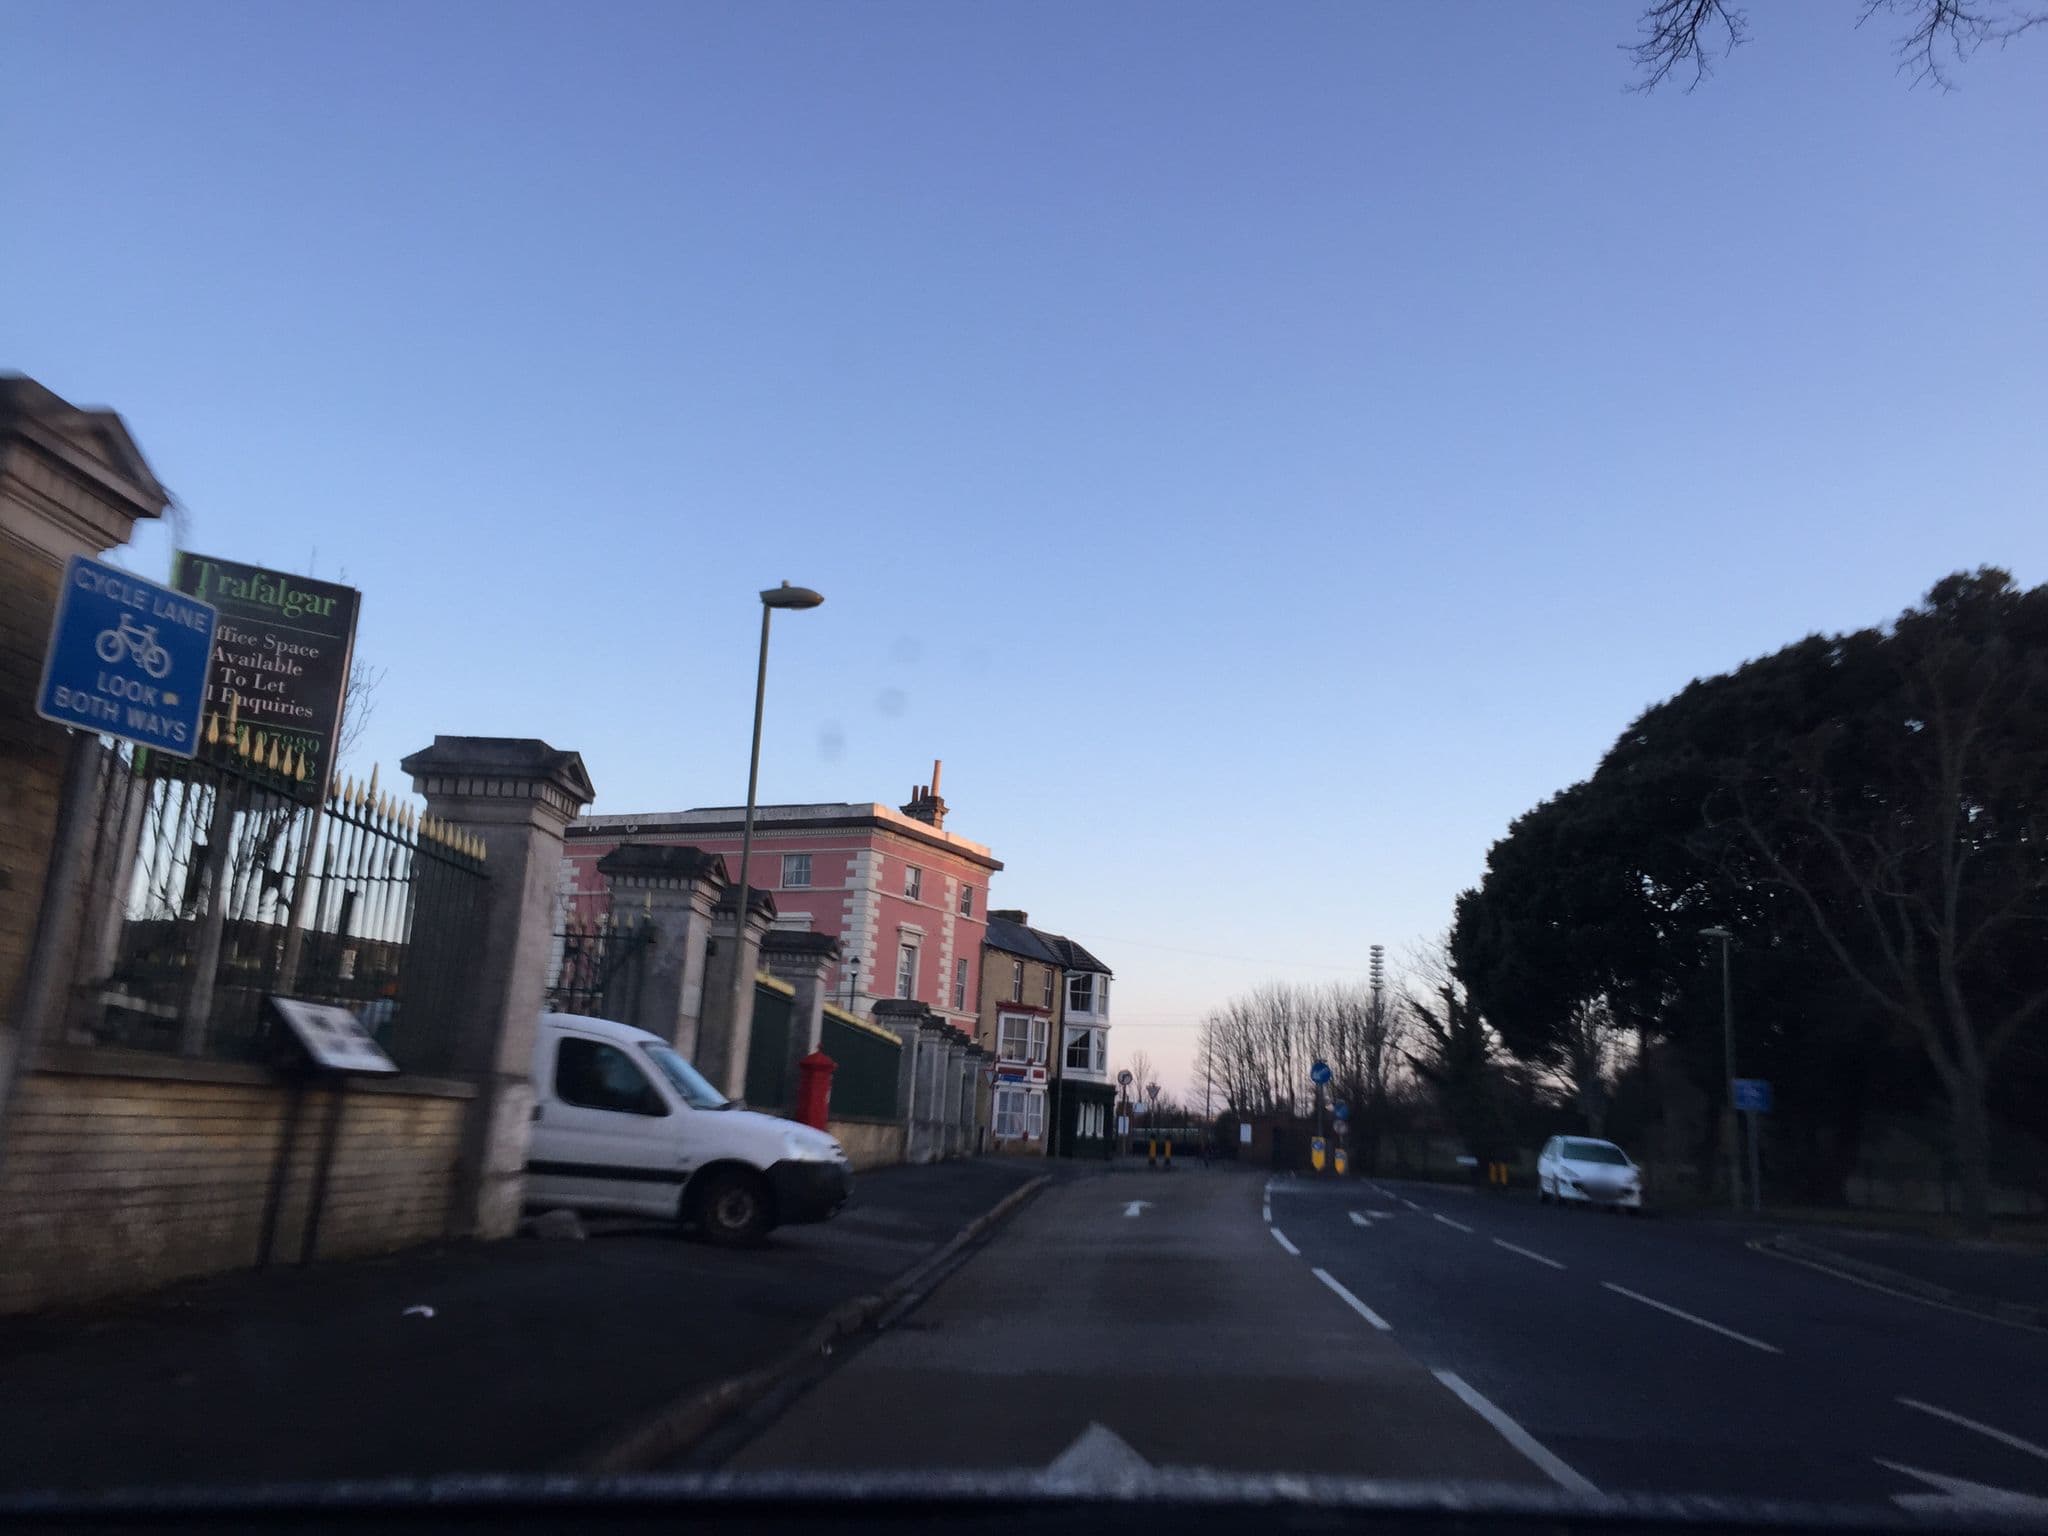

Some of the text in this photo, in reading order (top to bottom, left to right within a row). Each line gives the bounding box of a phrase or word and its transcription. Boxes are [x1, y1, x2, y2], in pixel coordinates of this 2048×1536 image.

[75, 566, 209, 634] CYCLE LANE
[192, 559, 337, 618] Trafalgar
[215, 624, 320, 660] ffice Space
[211, 645, 304, 677] Available
[96, 672, 159, 706] LOOK
[220, 667, 288, 694] To Let
[54, 685, 187, 742] BOTH WAYS
[221, 687, 314, 718] Enquiries
